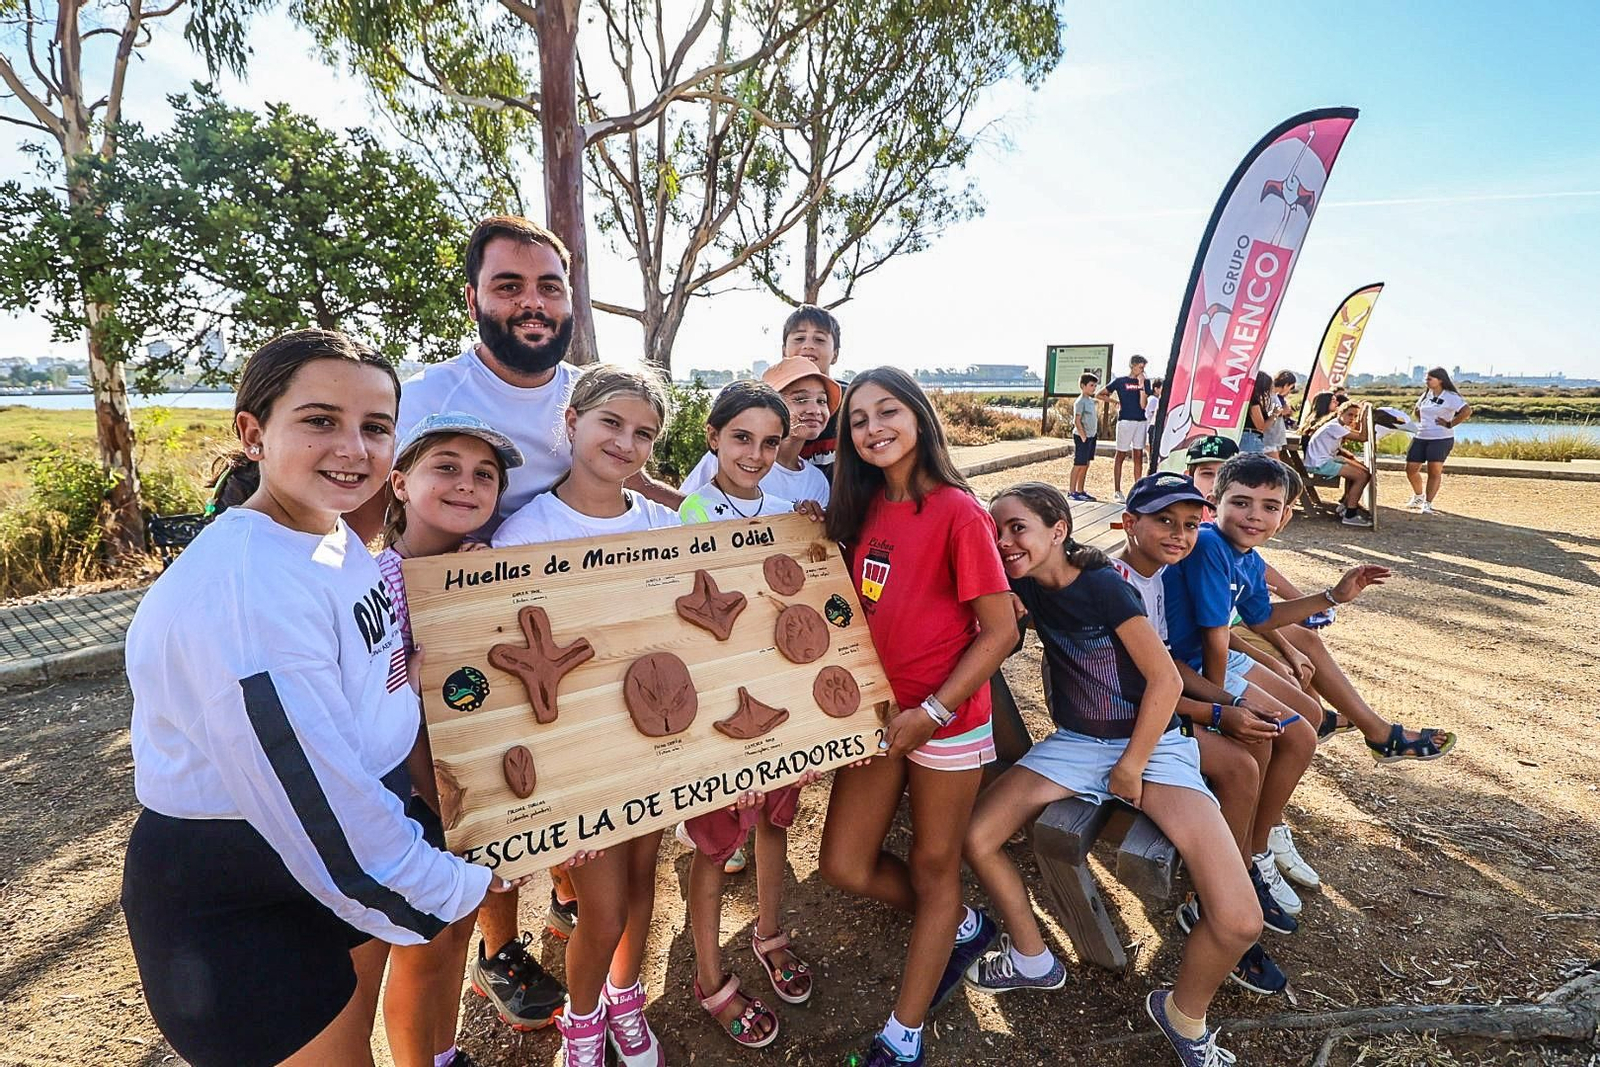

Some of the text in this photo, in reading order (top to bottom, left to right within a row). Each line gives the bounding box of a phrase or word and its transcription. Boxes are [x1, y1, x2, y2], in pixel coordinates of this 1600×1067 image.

[1222, 234, 1250, 296] GRUPO
[1328, 338, 1355, 387] GUILA
[445, 526, 776, 591] Huellas de Marismas del Odiel
[622, 793, 663, 826] DE
[671, 735, 865, 811] EXPLORADORES
[874, 728, 888, 750] 2
